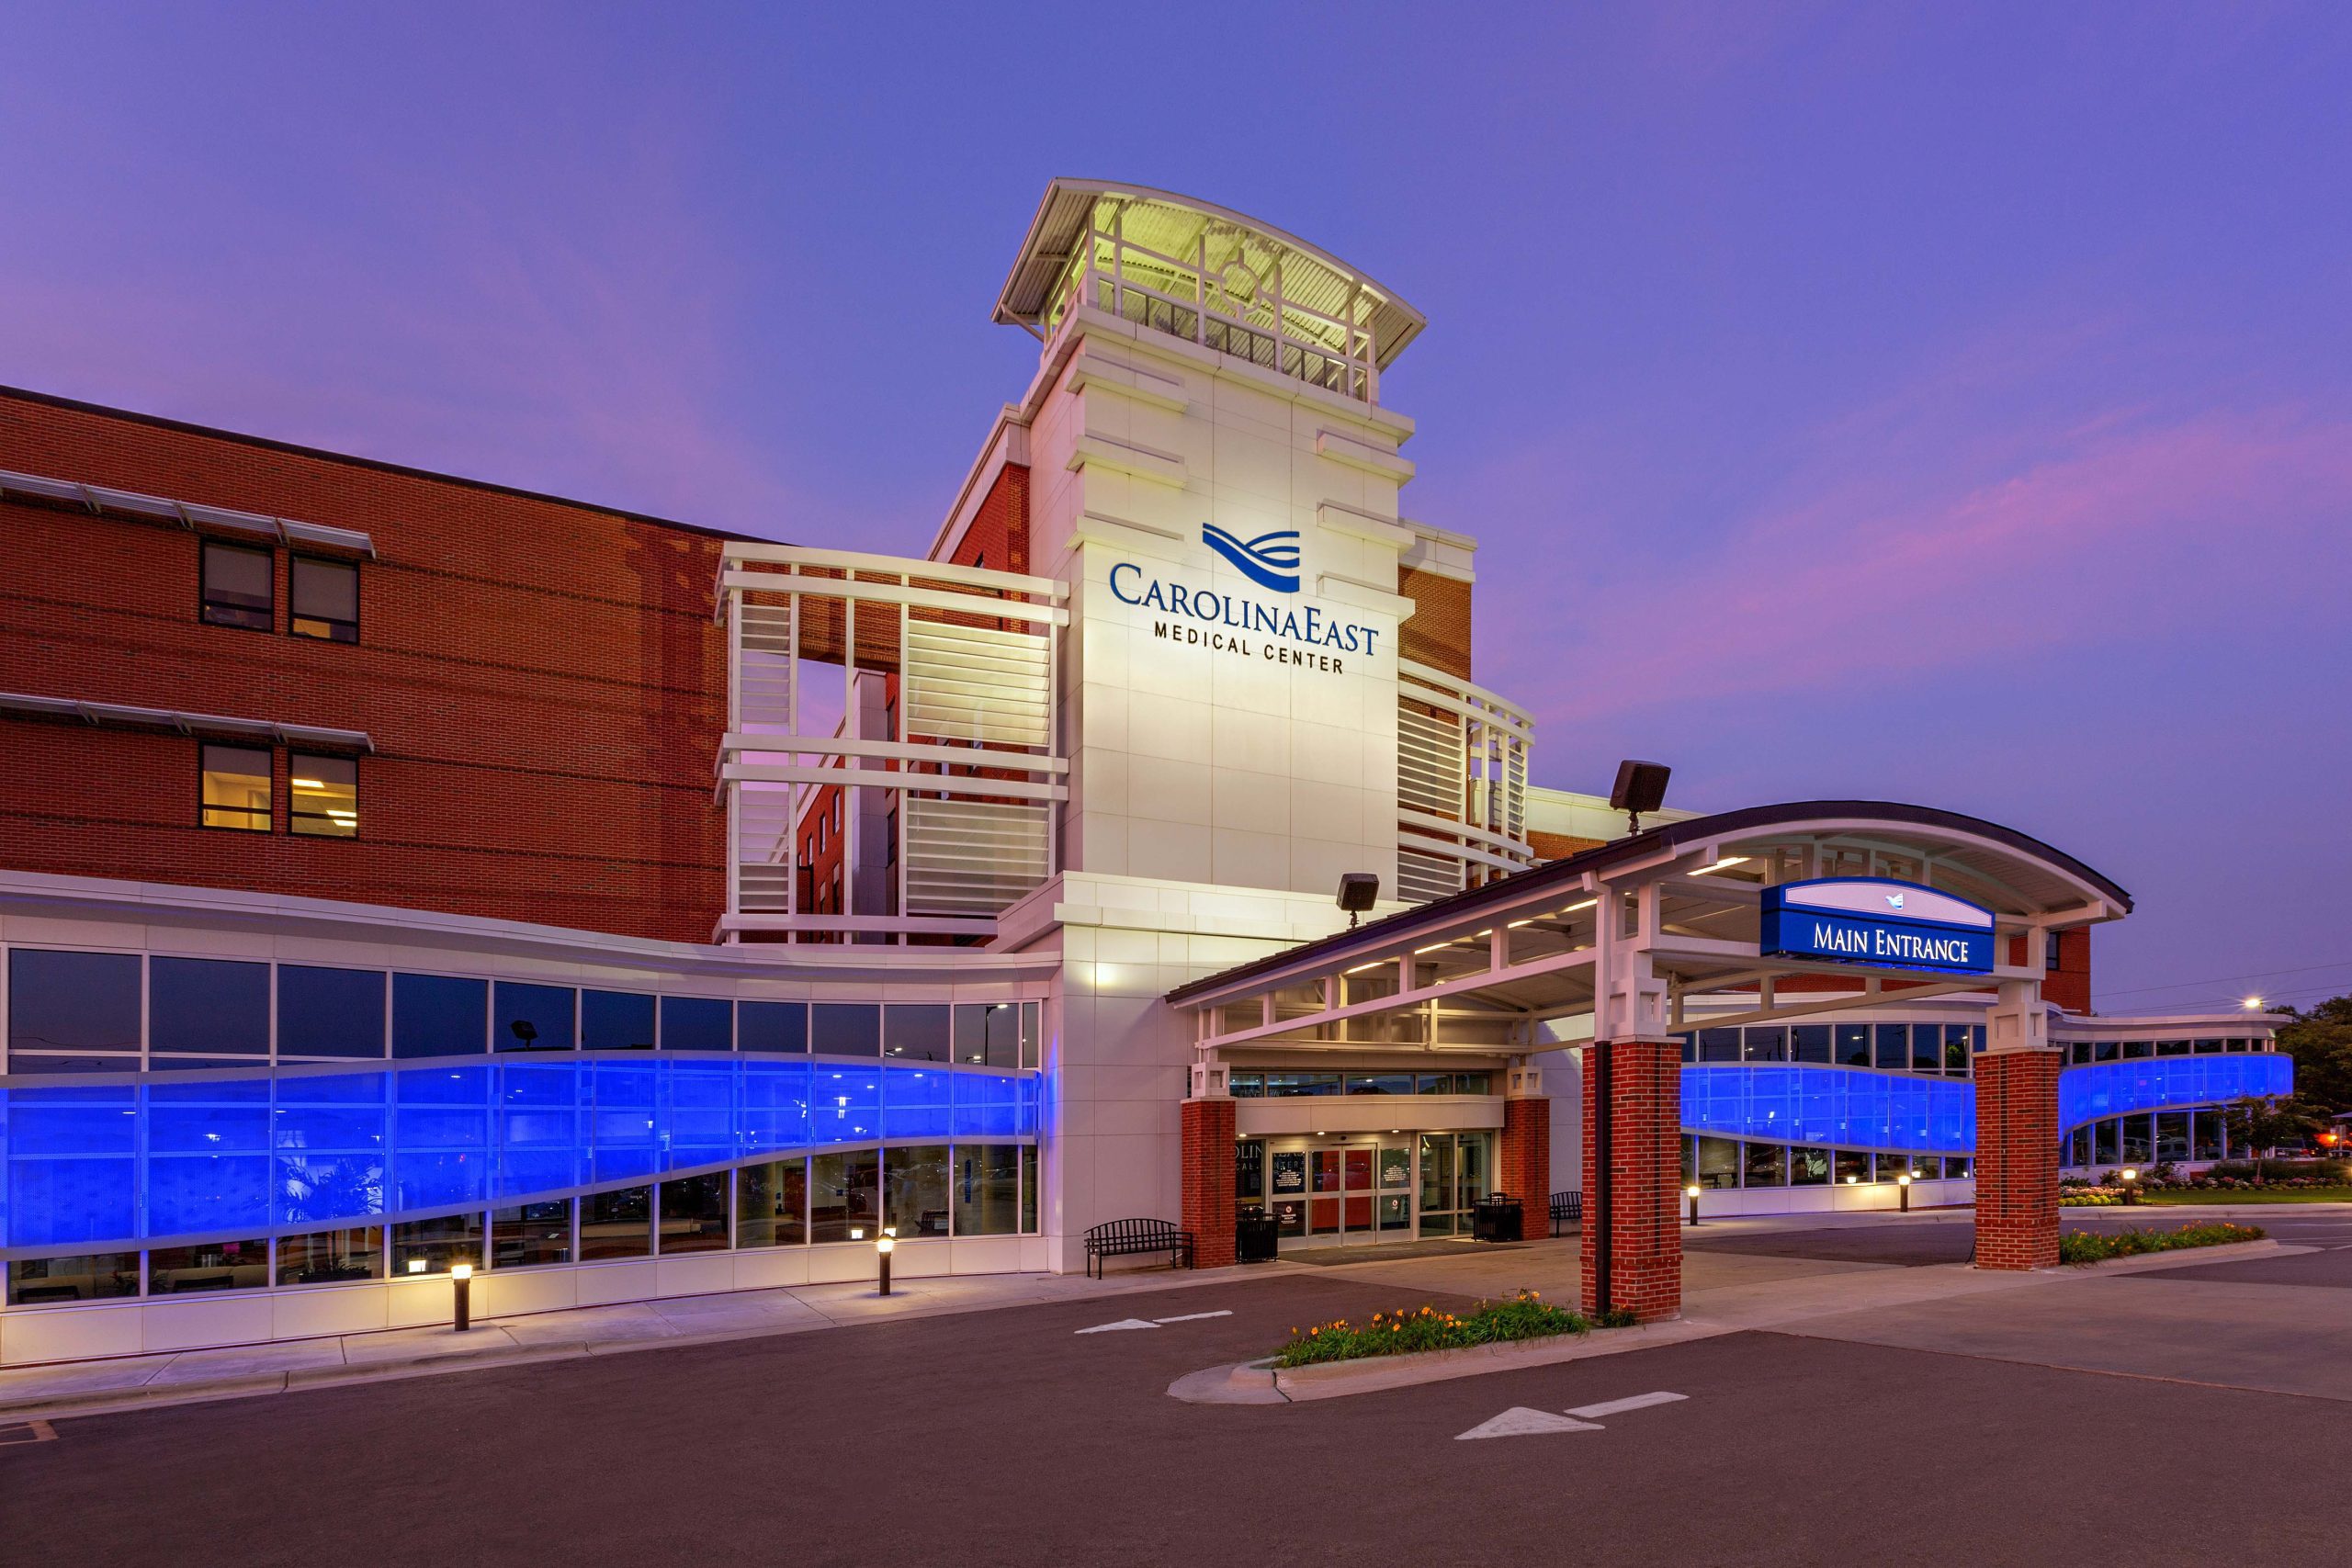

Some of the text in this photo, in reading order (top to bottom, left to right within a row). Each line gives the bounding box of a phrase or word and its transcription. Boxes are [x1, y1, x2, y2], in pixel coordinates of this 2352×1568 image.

[1109, 562, 1379, 657] CAROLINAEAST
[1155, 621, 1343, 674] MEDICAL CENTER
[1813, 922, 1969, 963] MAIN ENTRANCE
